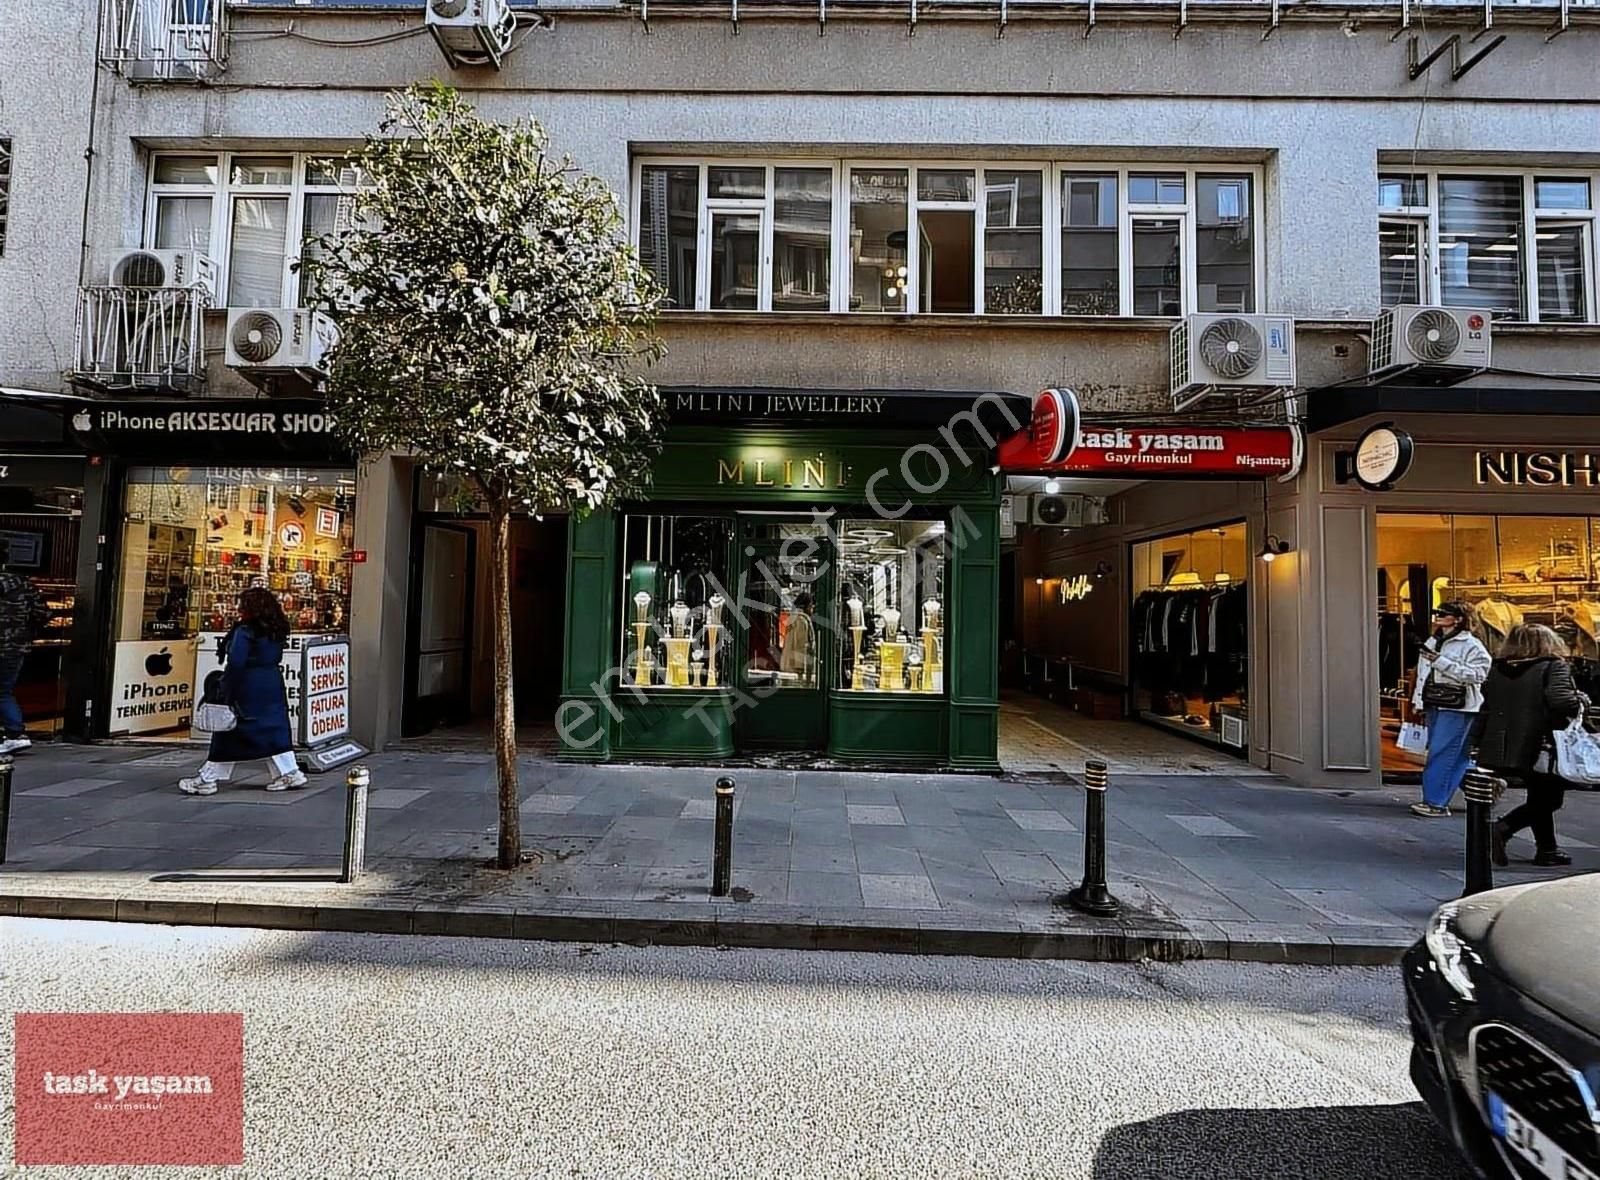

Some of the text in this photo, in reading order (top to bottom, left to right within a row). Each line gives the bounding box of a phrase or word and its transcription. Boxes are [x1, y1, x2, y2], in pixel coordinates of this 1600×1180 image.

[1468, 331, 1482, 340] LG
[676, 394, 886, 415] MLINI JEWELLERY
[100, 411, 165, 429] iPhone
[168, 412, 276, 433] AKSESUAR
[1078, 428, 1133, 448] task
[1138, 434, 1224, 452] yaşam
[1105, 452, 1193, 464] Gayrimenkul
[1236, 455, 1291, 468] Nişantaşı
[1476, 452, 1600, 486] NISH
[310, 649, 346, 671] TEKNİK
[124, 681, 189, 700] iPhone
[310, 668, 345, 692] SERVİS
[116, 696, 194, 719] TEKNİK SERVİS
[310, 694, 345, 715] FATURA
[311, 713, 345, 737] ÖDEME
